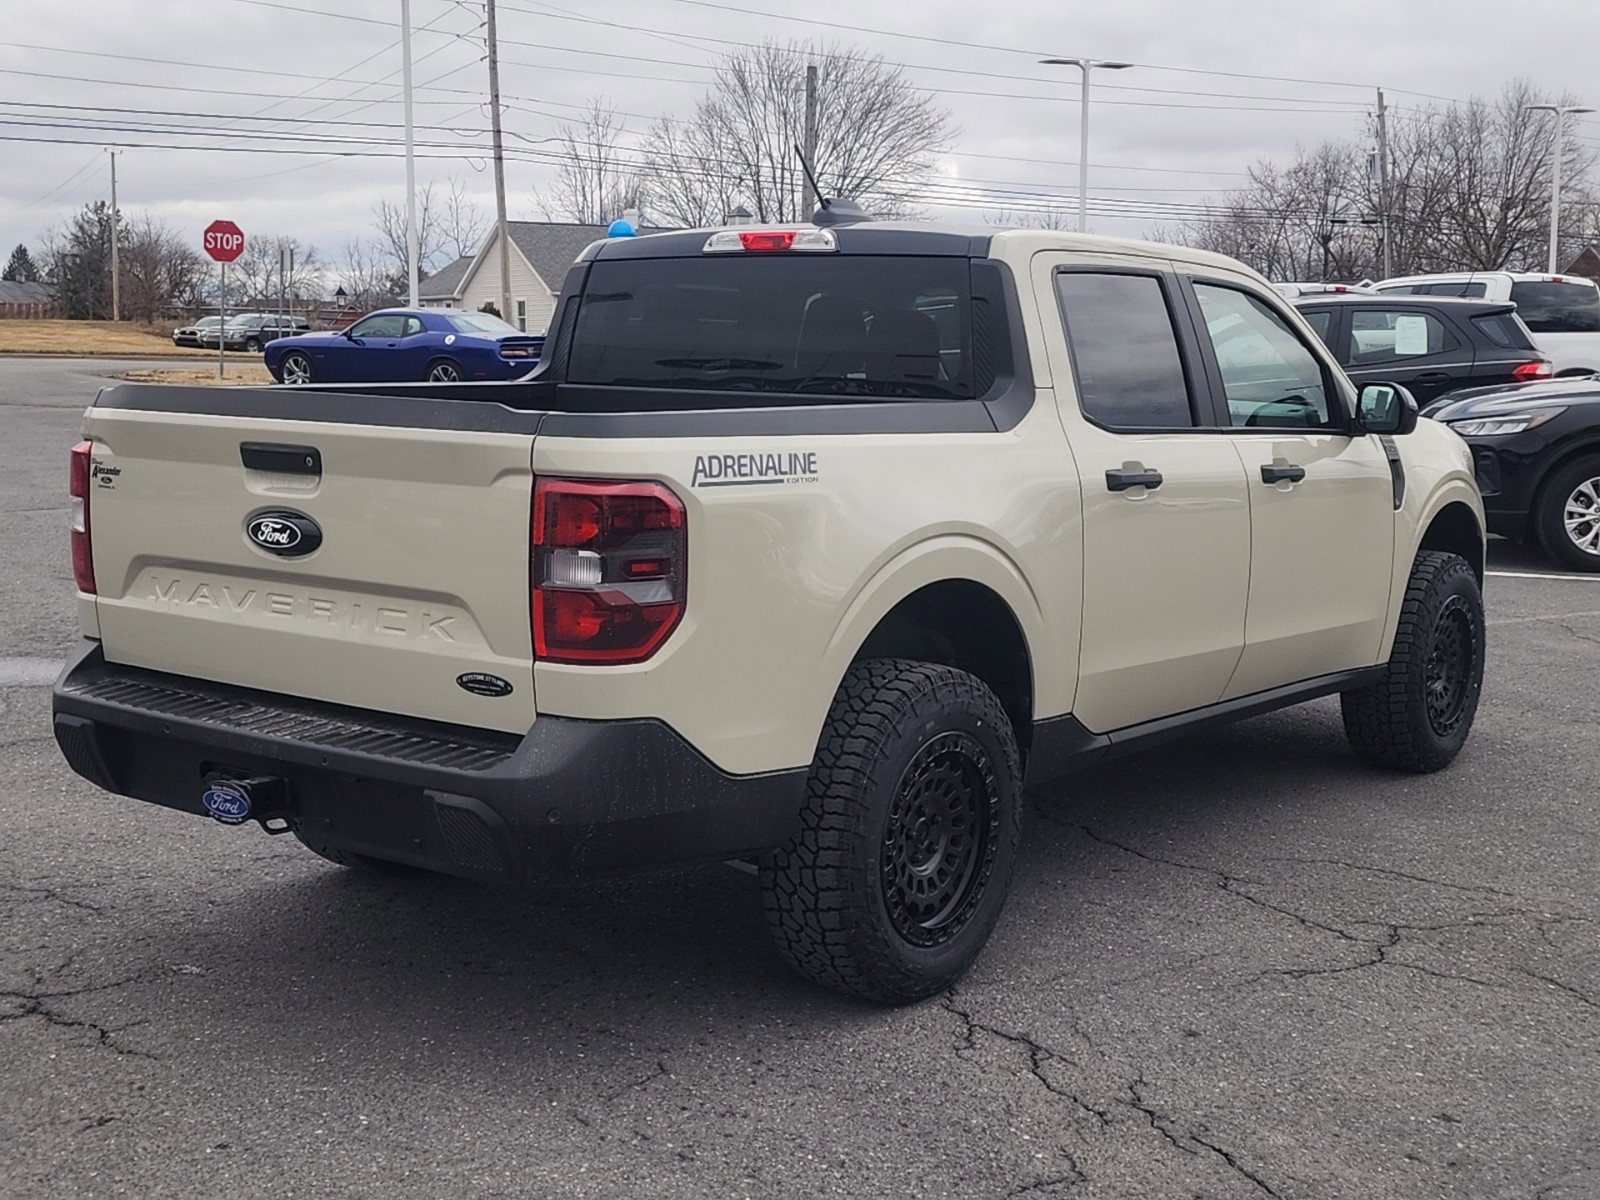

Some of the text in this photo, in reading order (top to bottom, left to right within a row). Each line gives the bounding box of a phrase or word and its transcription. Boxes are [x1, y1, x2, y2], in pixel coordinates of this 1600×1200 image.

[205, 232, 242, 250] STOP
[691, 452, 818, 487] ADRENALINE
[257, 521, 290, 543] Ford
[147, 575, 456, 643] MAVERICK
[210, 792, 240, 814] Ford
